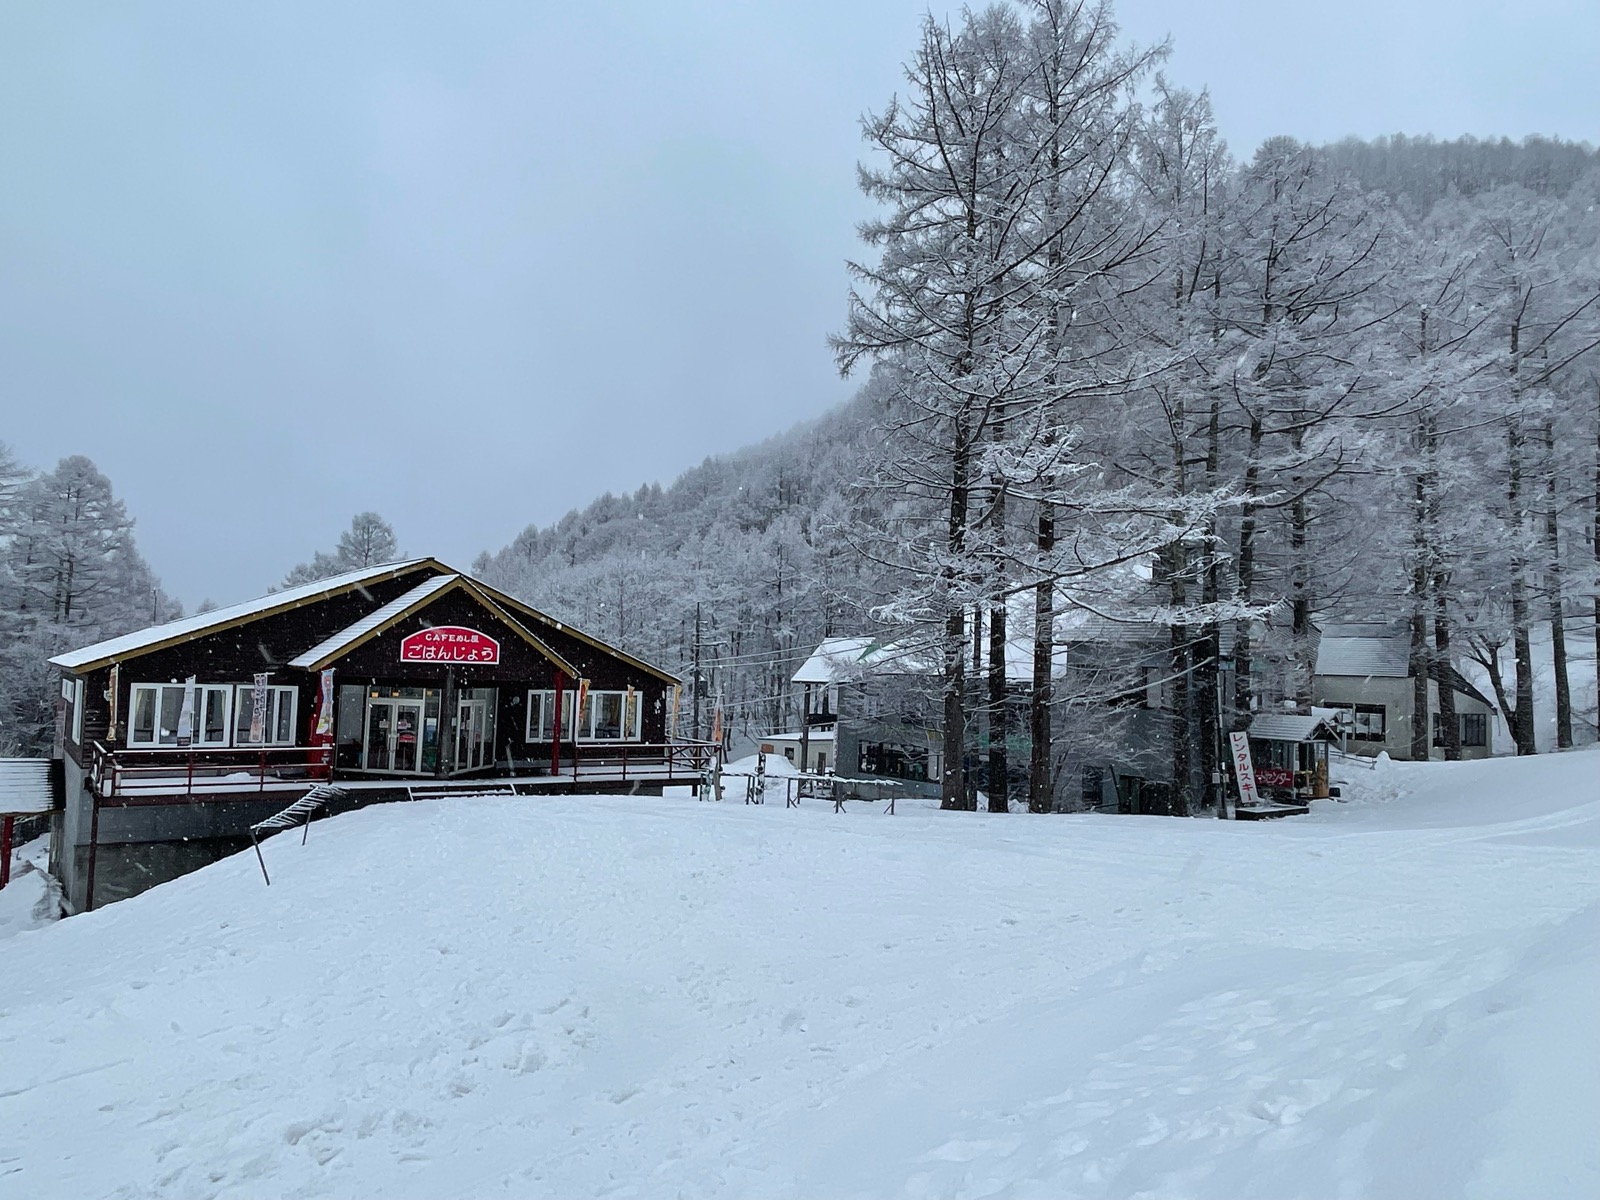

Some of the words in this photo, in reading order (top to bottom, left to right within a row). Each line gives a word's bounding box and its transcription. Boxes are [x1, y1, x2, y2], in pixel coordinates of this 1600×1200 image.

[407, 644, 494, 661] ごはんじょう
[1233, 734, 1253, 801] レンタルスキー
